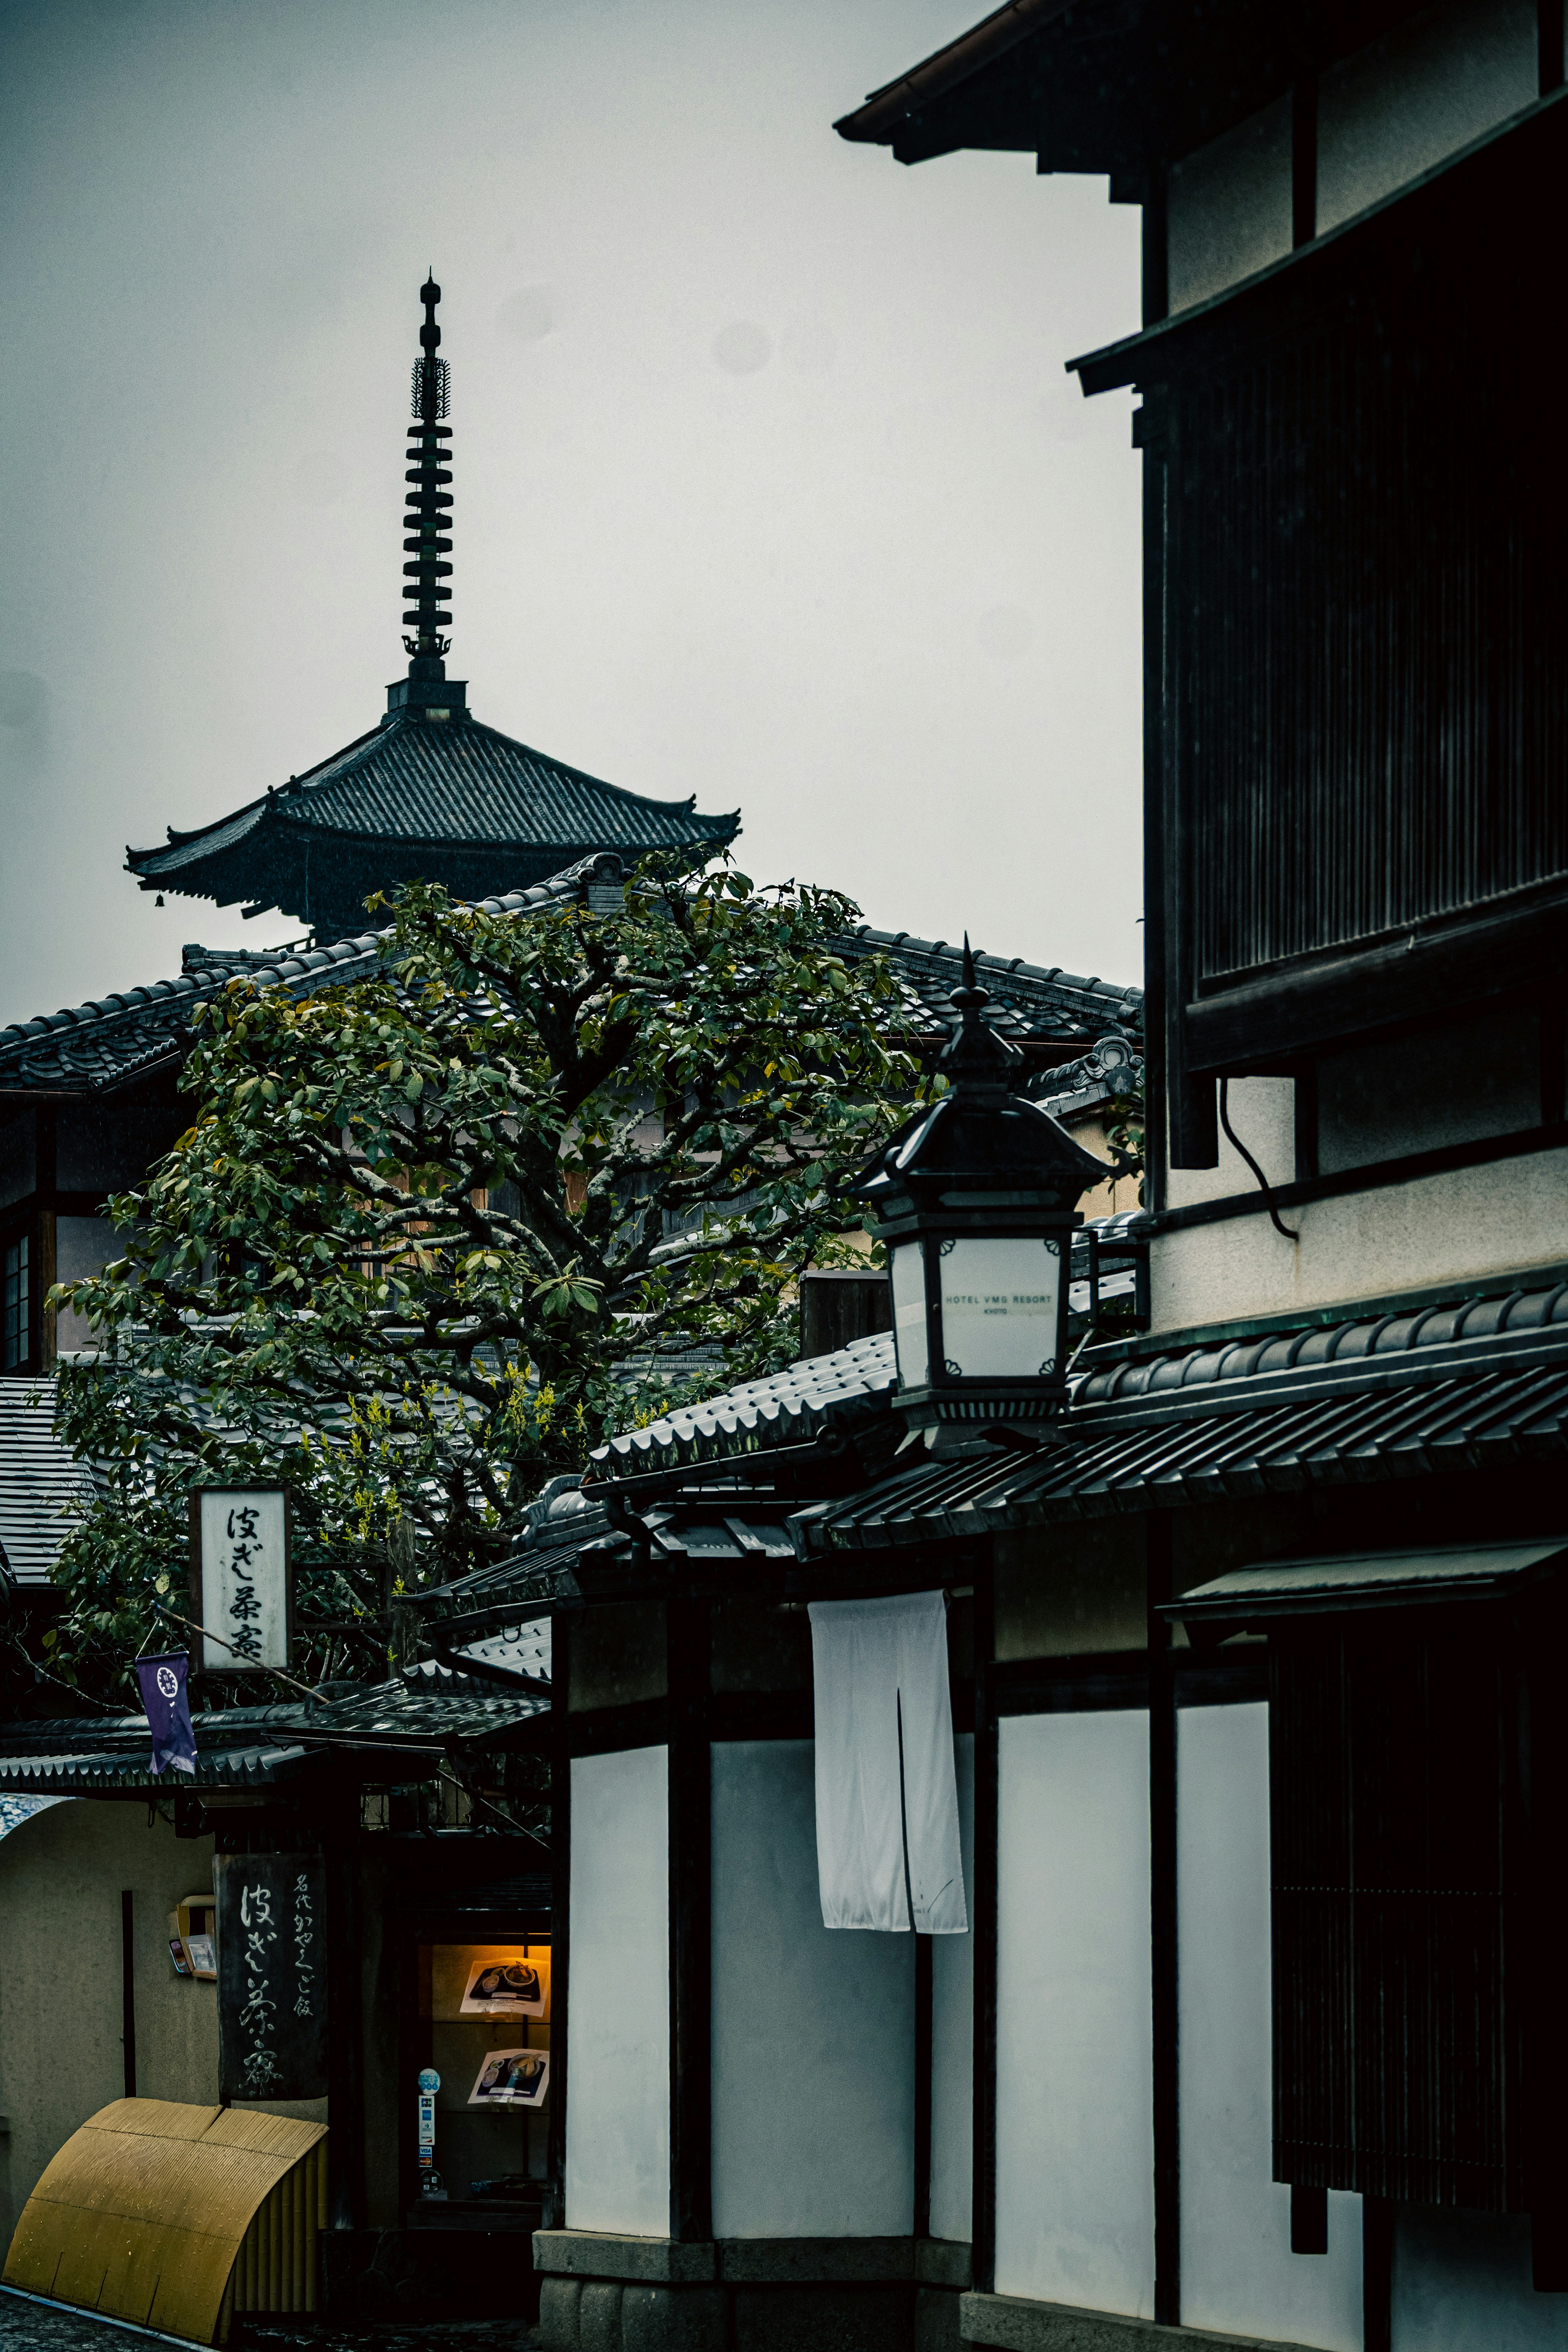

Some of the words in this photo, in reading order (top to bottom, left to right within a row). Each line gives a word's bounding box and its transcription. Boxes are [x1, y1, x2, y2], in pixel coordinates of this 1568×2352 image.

[946, 1296, 979, 1304] HOTEL
[984, 1296, 1007, 1304] VMG
[1013, 1295, 1052, 1304] RESORT
